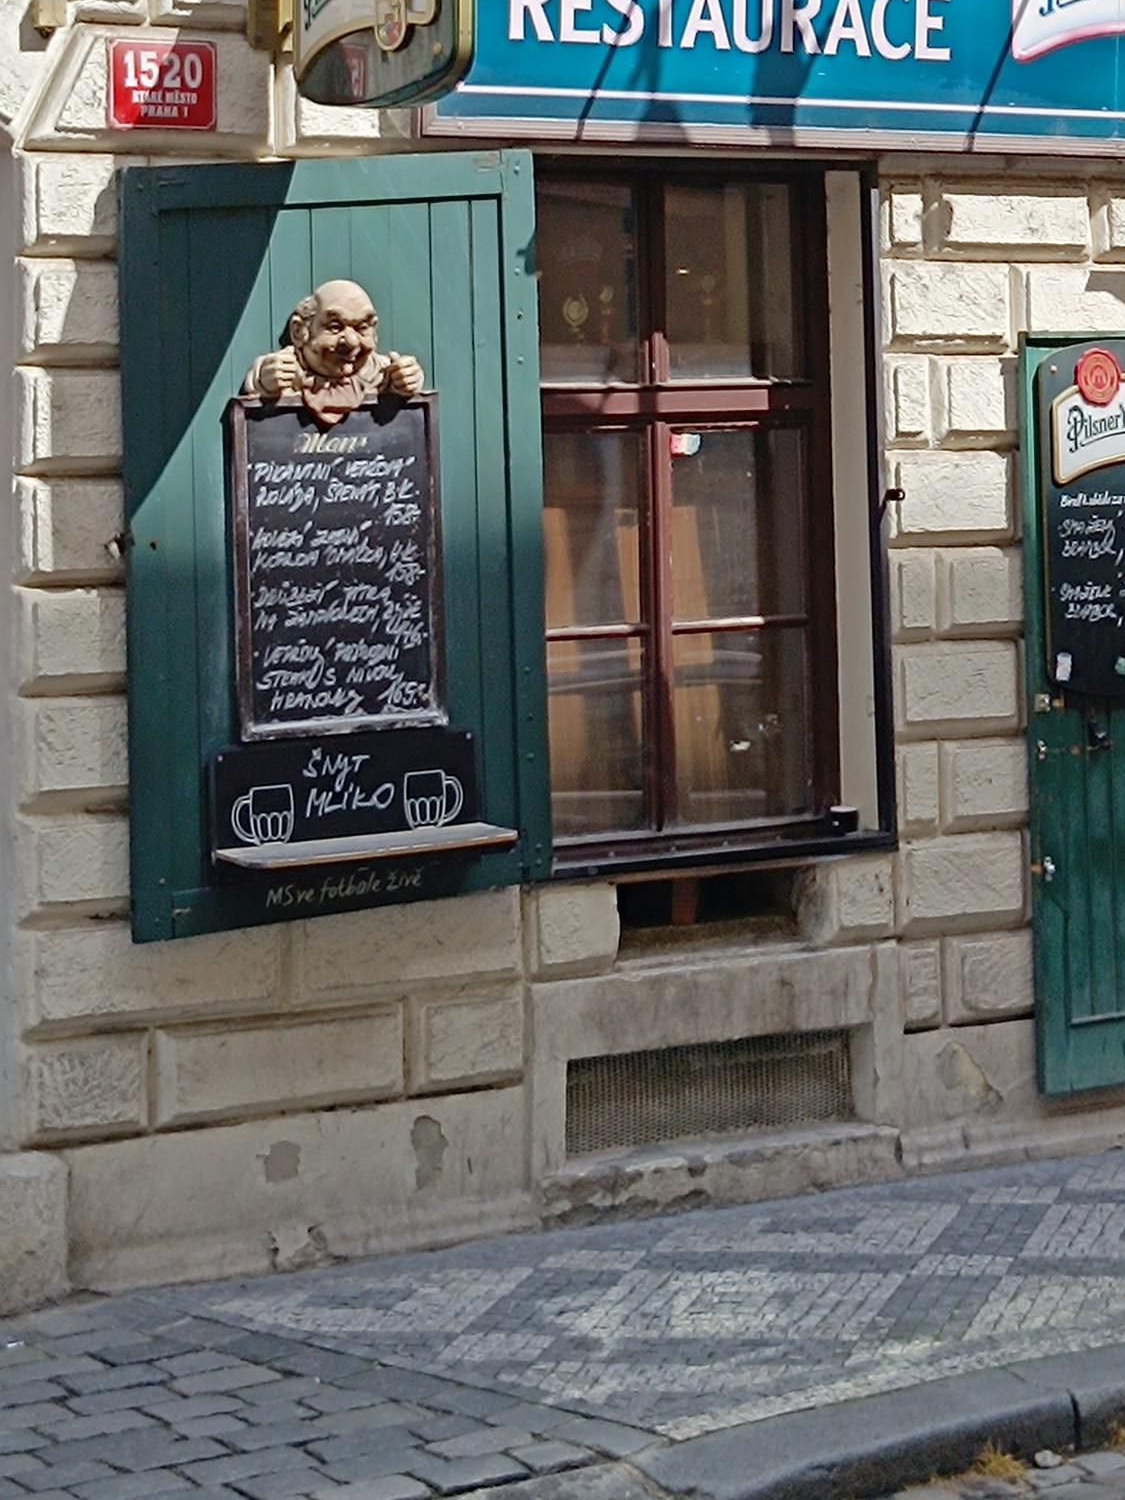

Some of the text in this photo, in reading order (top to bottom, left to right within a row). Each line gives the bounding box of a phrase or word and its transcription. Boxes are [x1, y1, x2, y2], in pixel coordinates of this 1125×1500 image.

[124, 50, 203, 89] 1520
[141, 105, 179, 117] PRAHA
[1067, 404, 1121, 453] Pilsner
[305, 782, 396, 818] MLÍKO
[265, 884, 294, 908] MS
